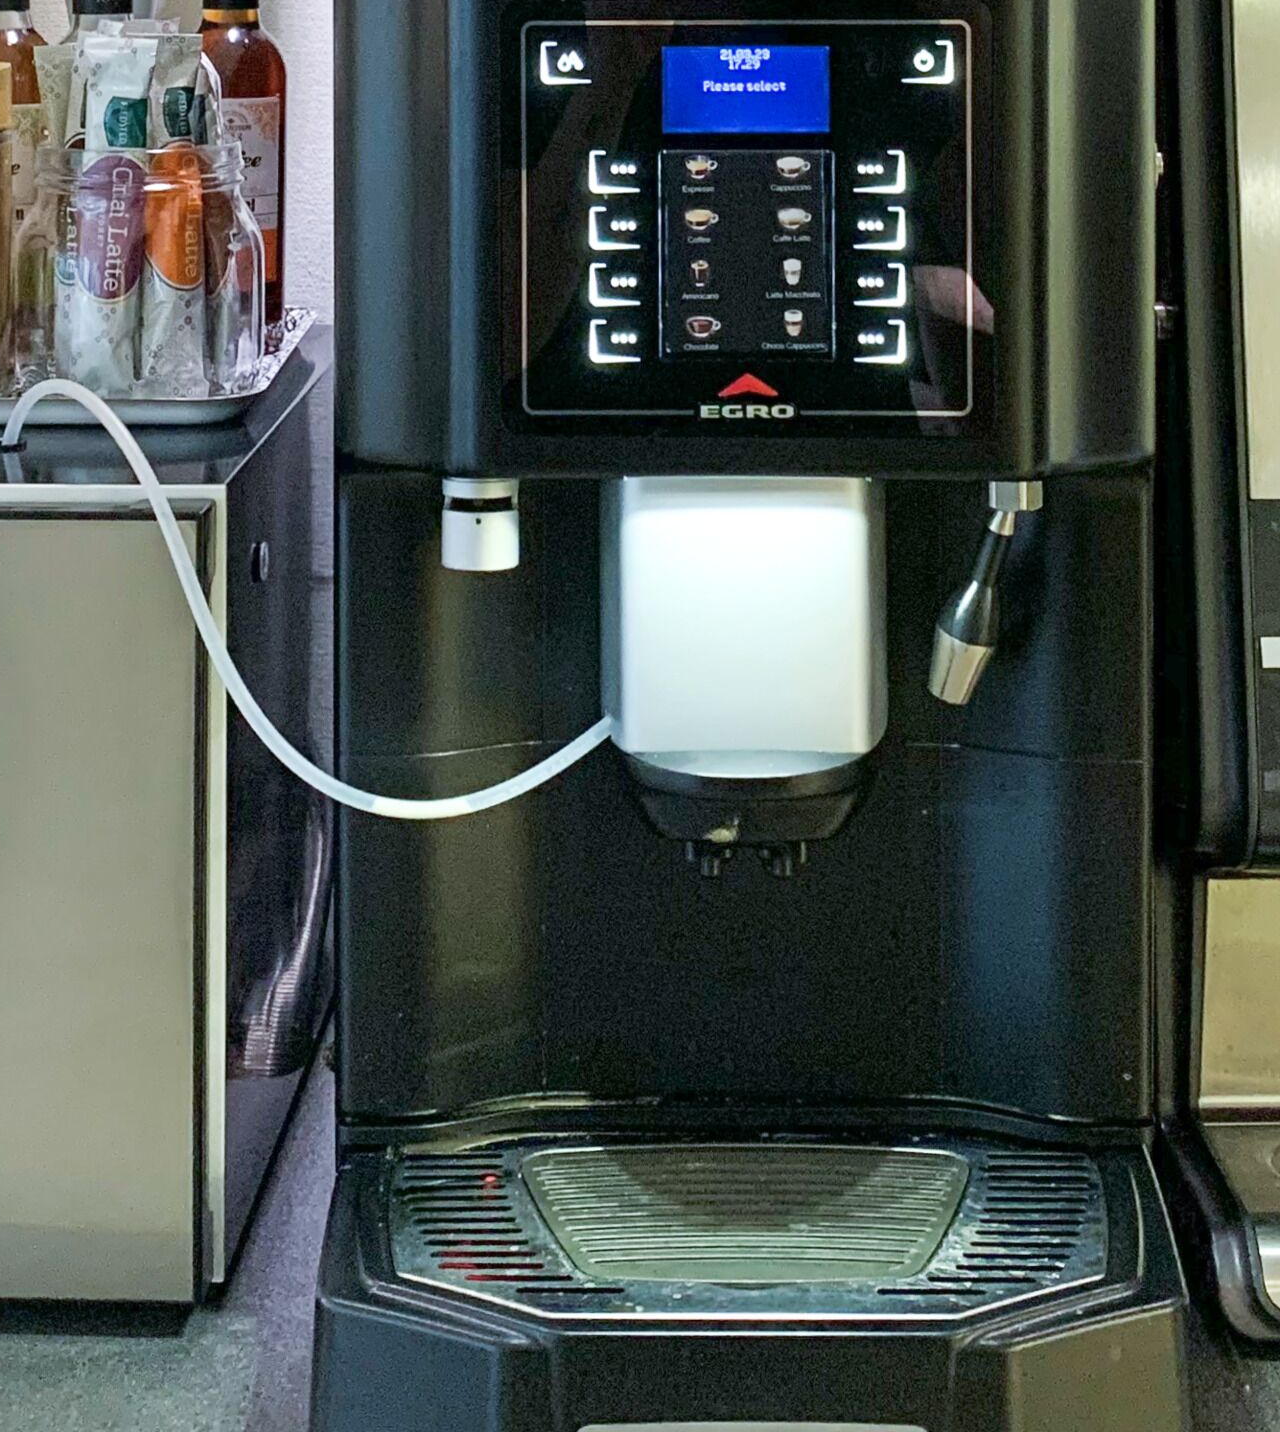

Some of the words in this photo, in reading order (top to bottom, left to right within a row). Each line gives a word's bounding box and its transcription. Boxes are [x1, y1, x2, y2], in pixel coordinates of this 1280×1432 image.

[703, 80, 745, 93] Please
[746, 80, 787, 93] select
[770, 184, 812, 193] Cappuccino
[103, 223, 128, 293] Latte
[699, 404, 796, 419] EGRO
